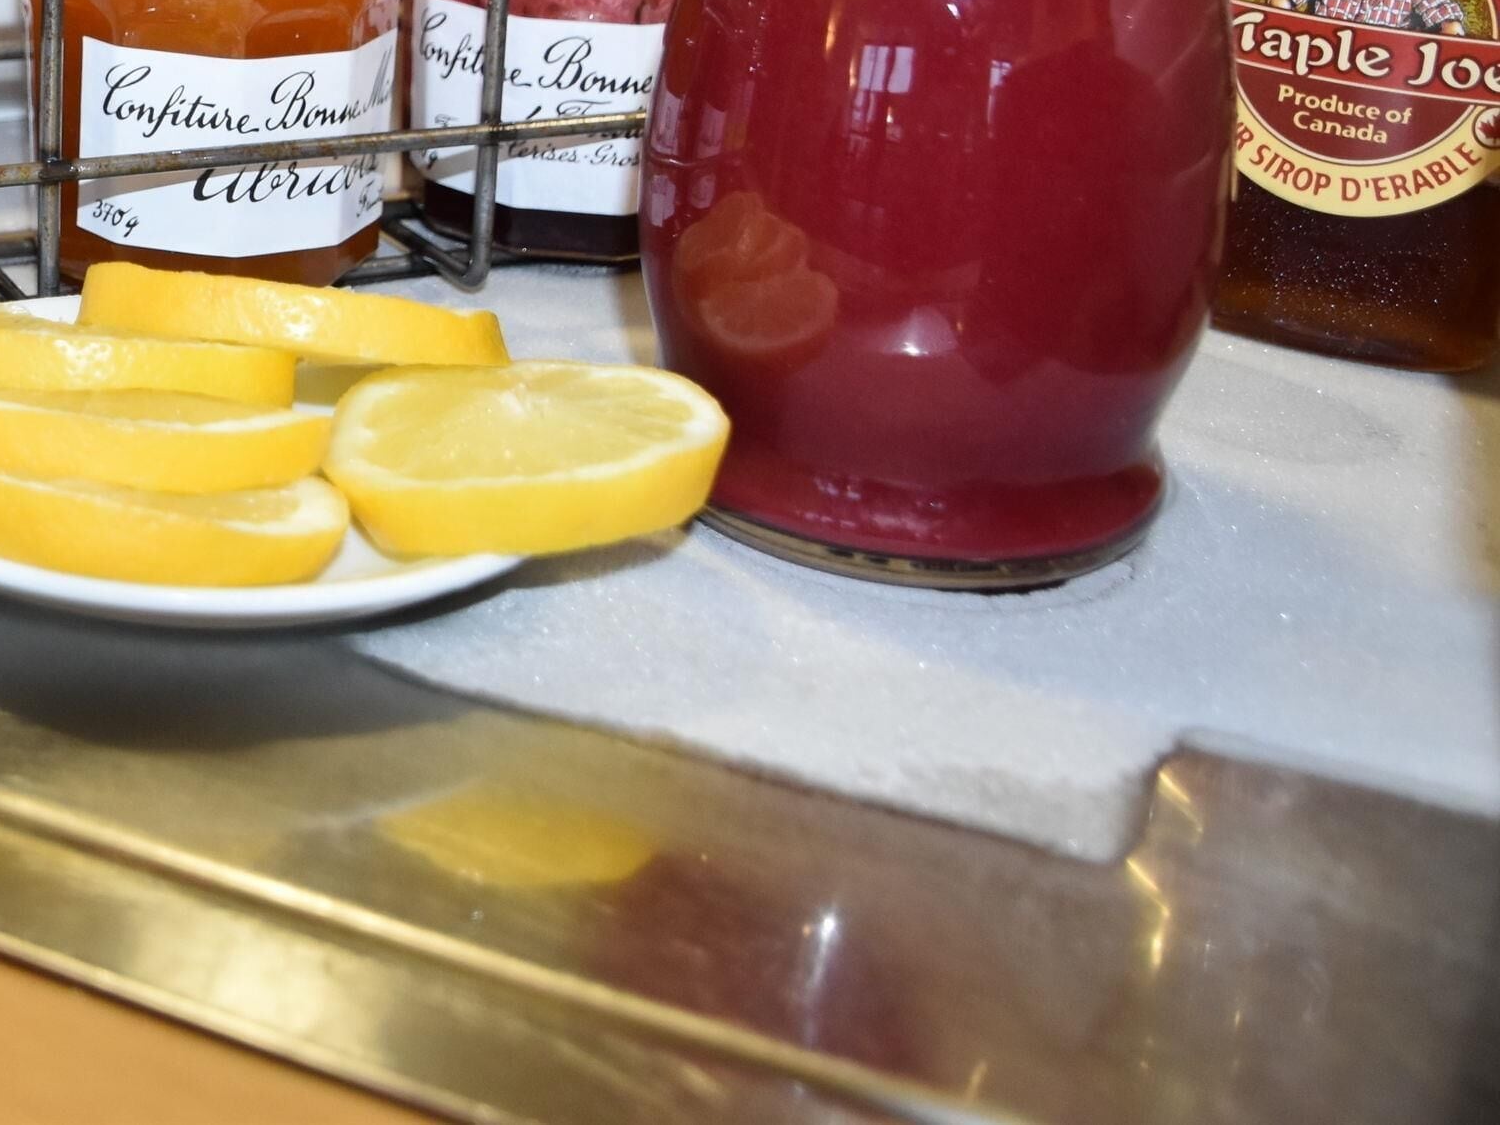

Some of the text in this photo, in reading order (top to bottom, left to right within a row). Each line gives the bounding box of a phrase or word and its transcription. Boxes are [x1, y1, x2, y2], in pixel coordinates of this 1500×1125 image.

[420, 9, 652, 94] Confite Bonne
[102, 62, 260, 138] Confiture
[265, 70, 363, 129] Bonne
[1278, 84, 1413, 125] Produce of
[1293, 111, 1388, 144] Canada
[1249, 139, 1483, 203] SIROP D'ERABLE
